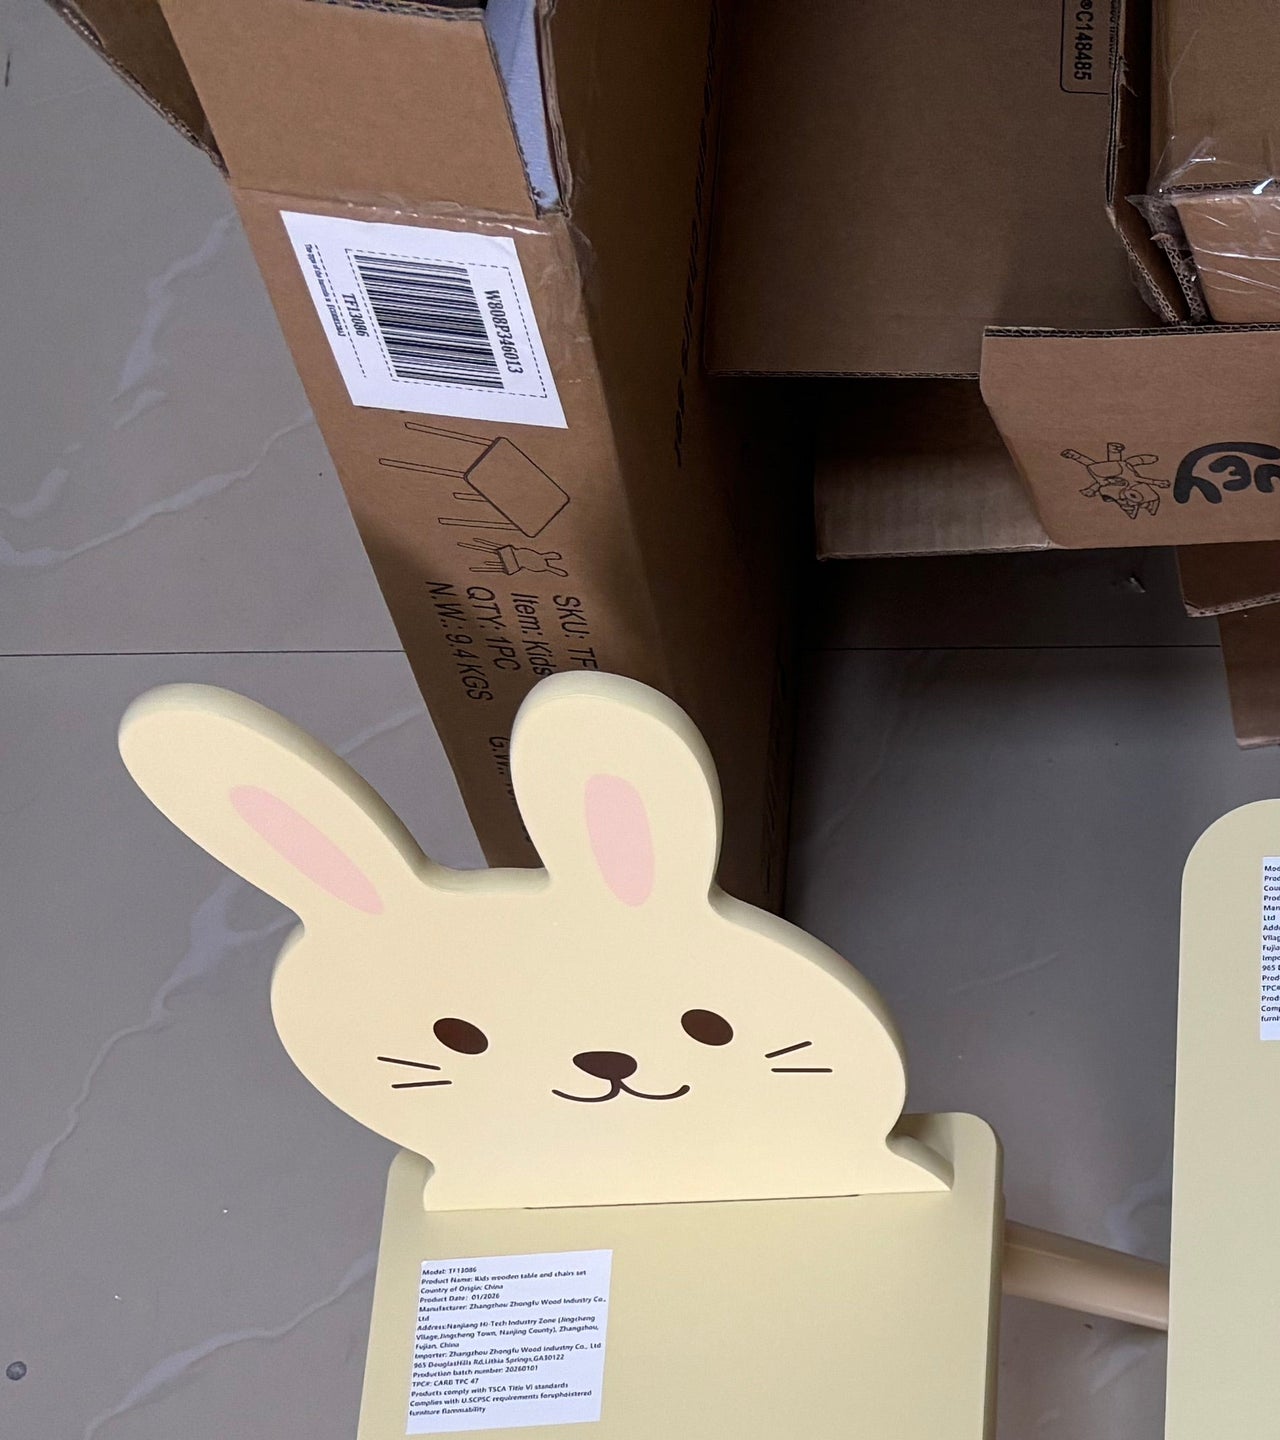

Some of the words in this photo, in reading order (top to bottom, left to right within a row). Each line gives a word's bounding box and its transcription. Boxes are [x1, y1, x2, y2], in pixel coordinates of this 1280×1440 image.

[342, 293, 369, 337] TF13086
[484, 289, 524, 374] W808P346013
[425, 582, 467, 629] N.W.:
[511, 593, 542, 635] Item:
[552, 595, 589, 639] SKU:
[446, 634, 479, 660] 9.4
[466, 586, 506, 630] QTY:
[486, 636, 520, 671] 1PC
[522, 639, 556, 677] Kids
[457, 663, 493, 701] KGS
